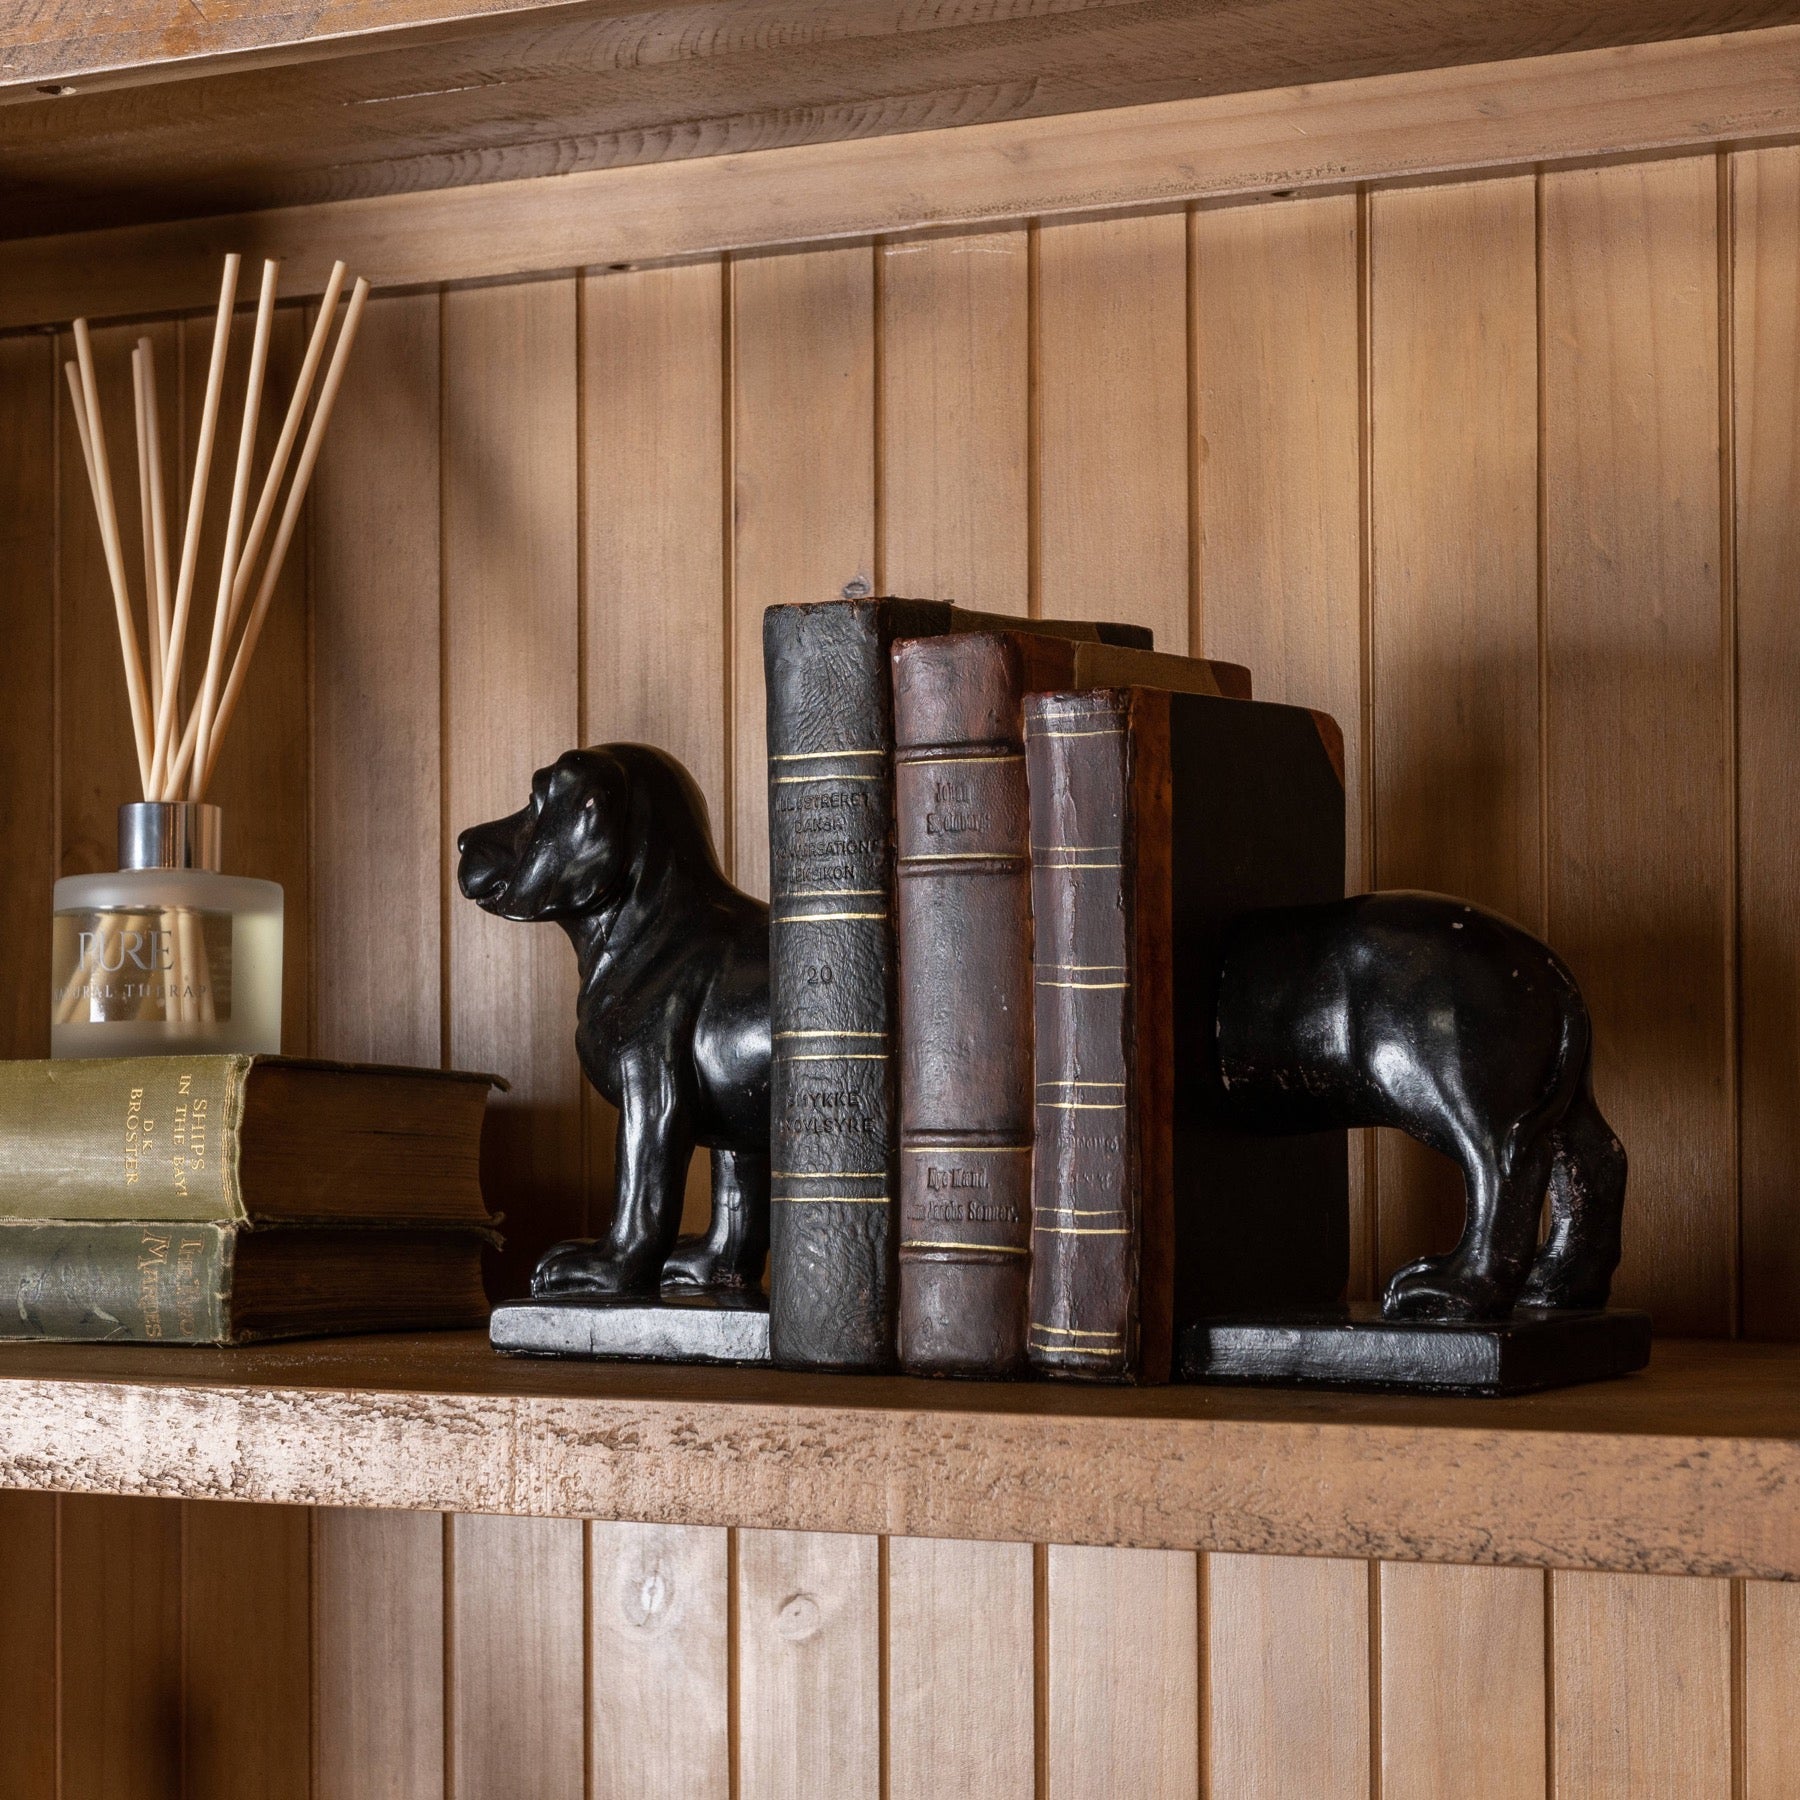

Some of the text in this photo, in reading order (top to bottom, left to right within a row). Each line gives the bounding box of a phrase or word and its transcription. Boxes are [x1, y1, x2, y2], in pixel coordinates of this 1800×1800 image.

[78, 930, 175, 972] PURE
[807, 965, 833, 984] 20
[125, 1088, 143, 1185] BROSTER
[173, 1074, 192, 1196] IN THE BAY!
[191, 1099, 207, 1170] SHIPS
